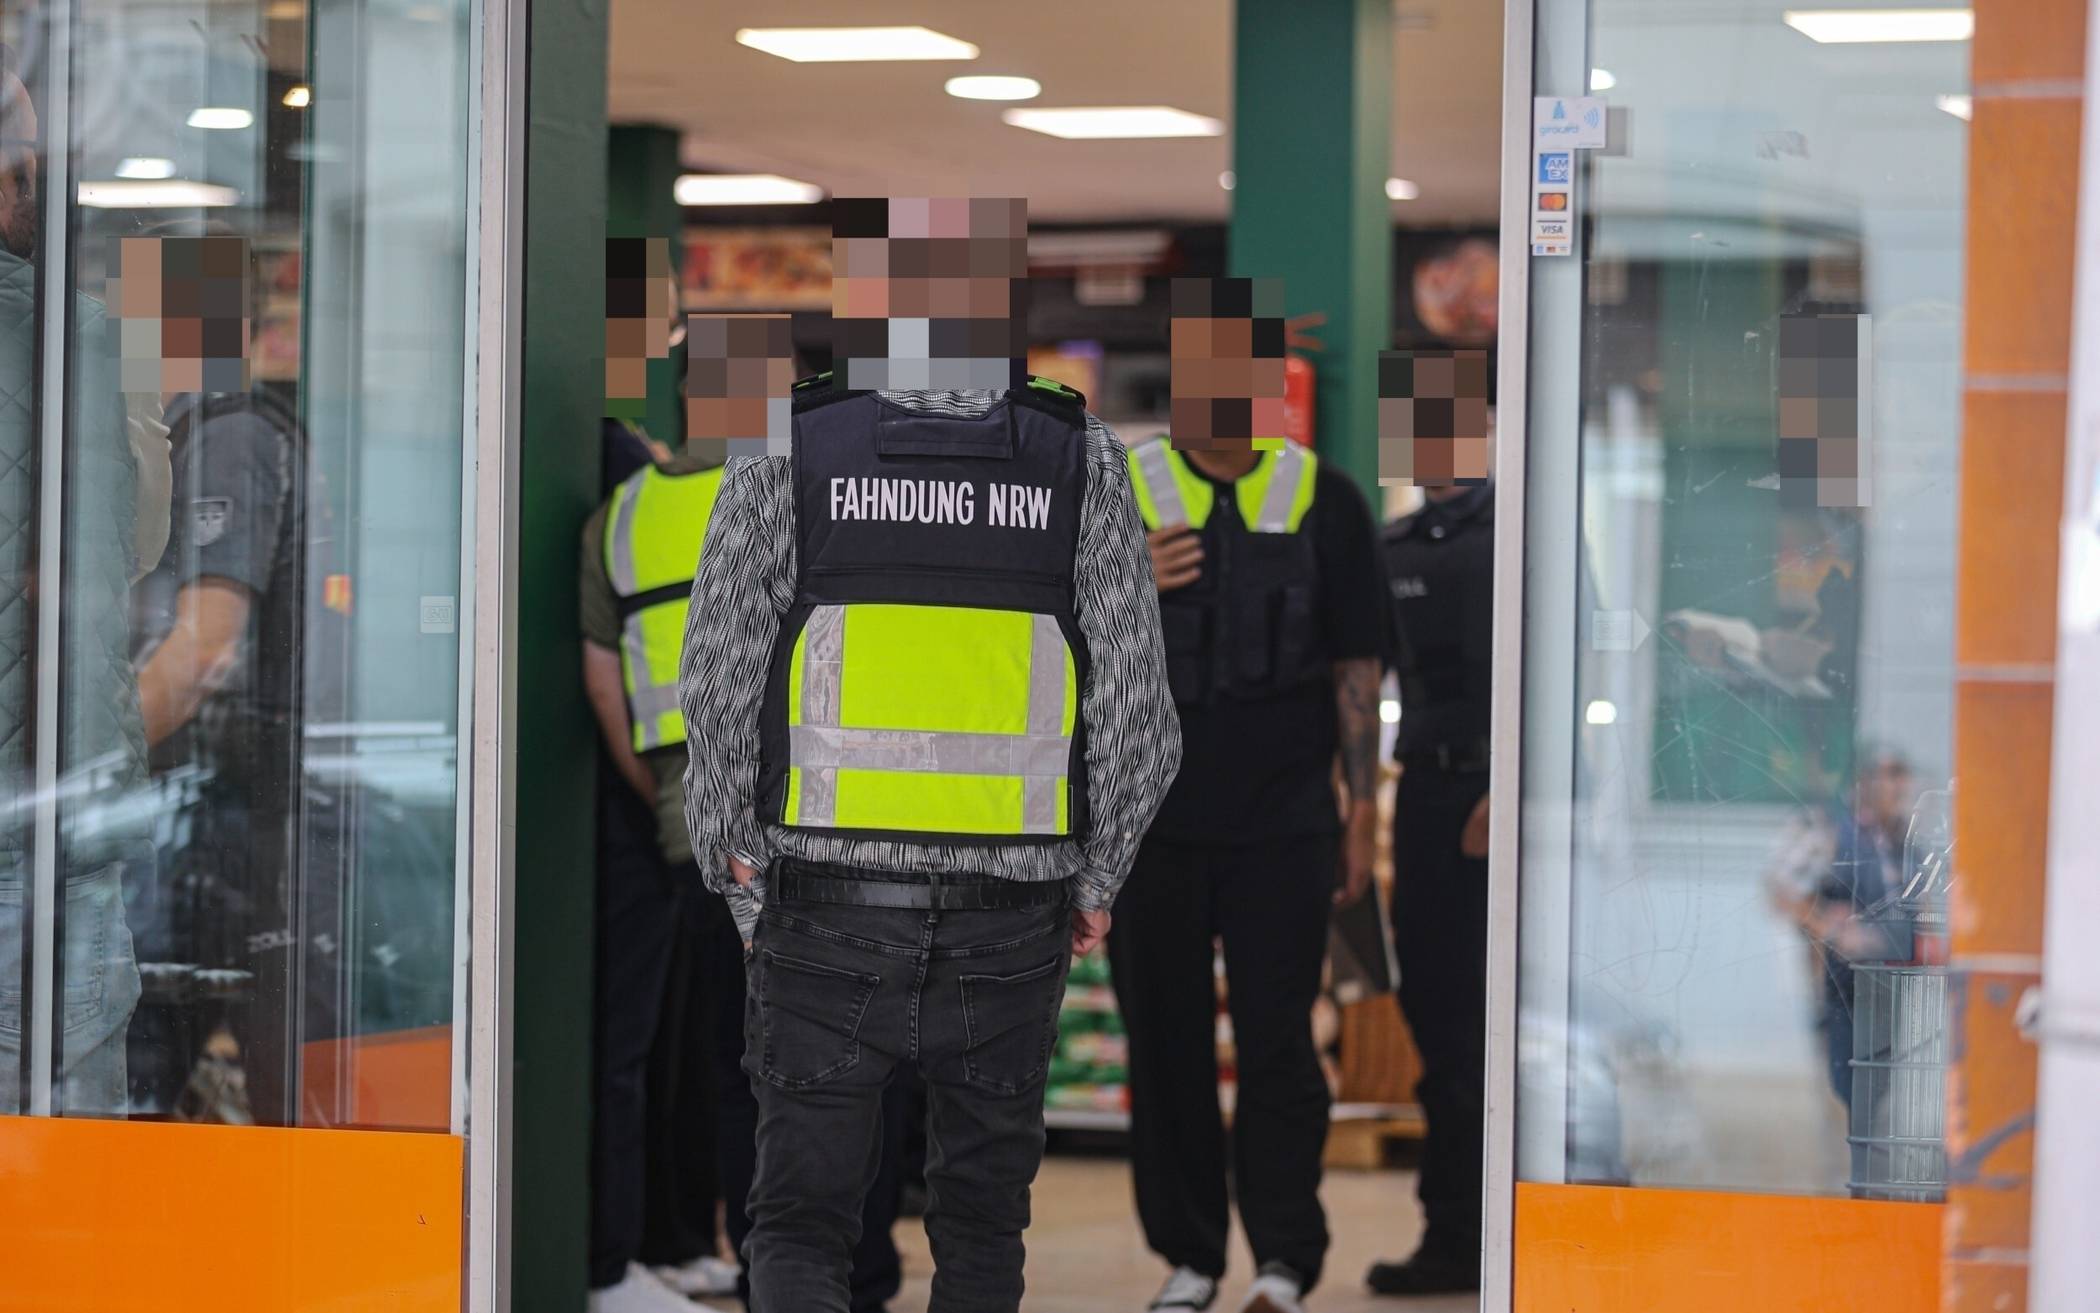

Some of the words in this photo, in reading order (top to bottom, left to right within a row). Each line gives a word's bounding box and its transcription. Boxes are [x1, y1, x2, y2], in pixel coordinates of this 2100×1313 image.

[1547, 159, 1569, 169] AM
[1550, 169, 1569, 179] EX
[1541, 224, 1563, 234] VISA
[830, 477, 975, 526] FAHNDUNG
[988, 482, 1052, 530] NRW
